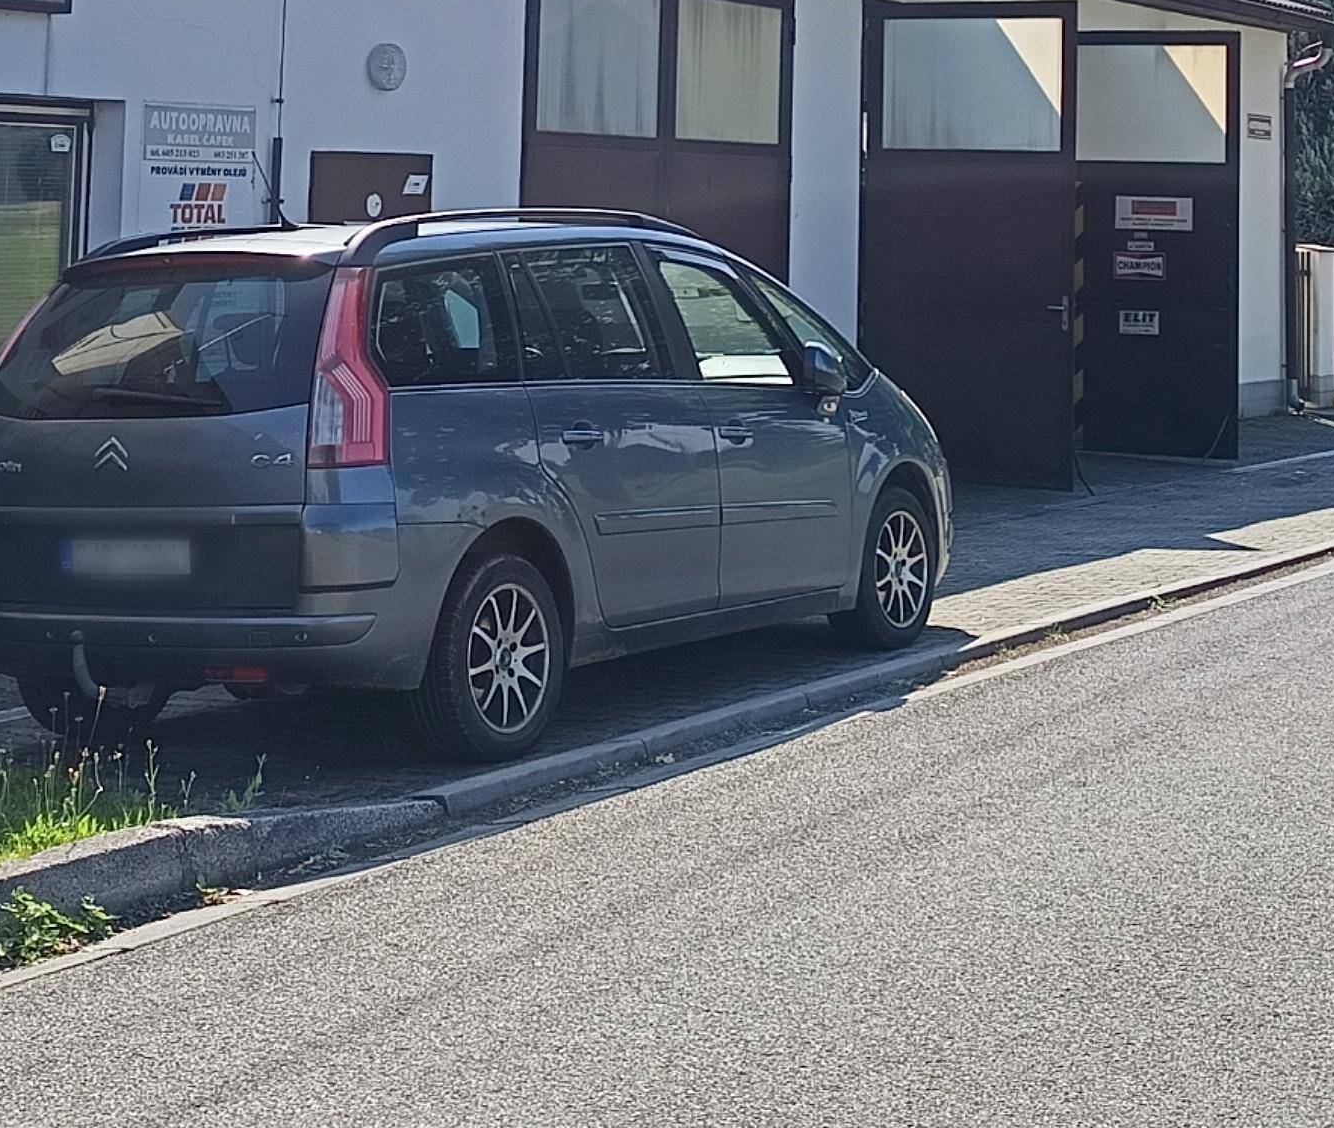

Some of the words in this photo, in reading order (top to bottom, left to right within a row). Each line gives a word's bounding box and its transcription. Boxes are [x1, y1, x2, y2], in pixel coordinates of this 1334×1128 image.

[149, 111, 251, 133] AUTOOPRAVNA
[167, 133, 200, 145] KAREL
[170, 204, 226, 224] TOTAL
[1117, 260, 1163, 272] CHAMPION
[251, 452, 294, 468] C4
